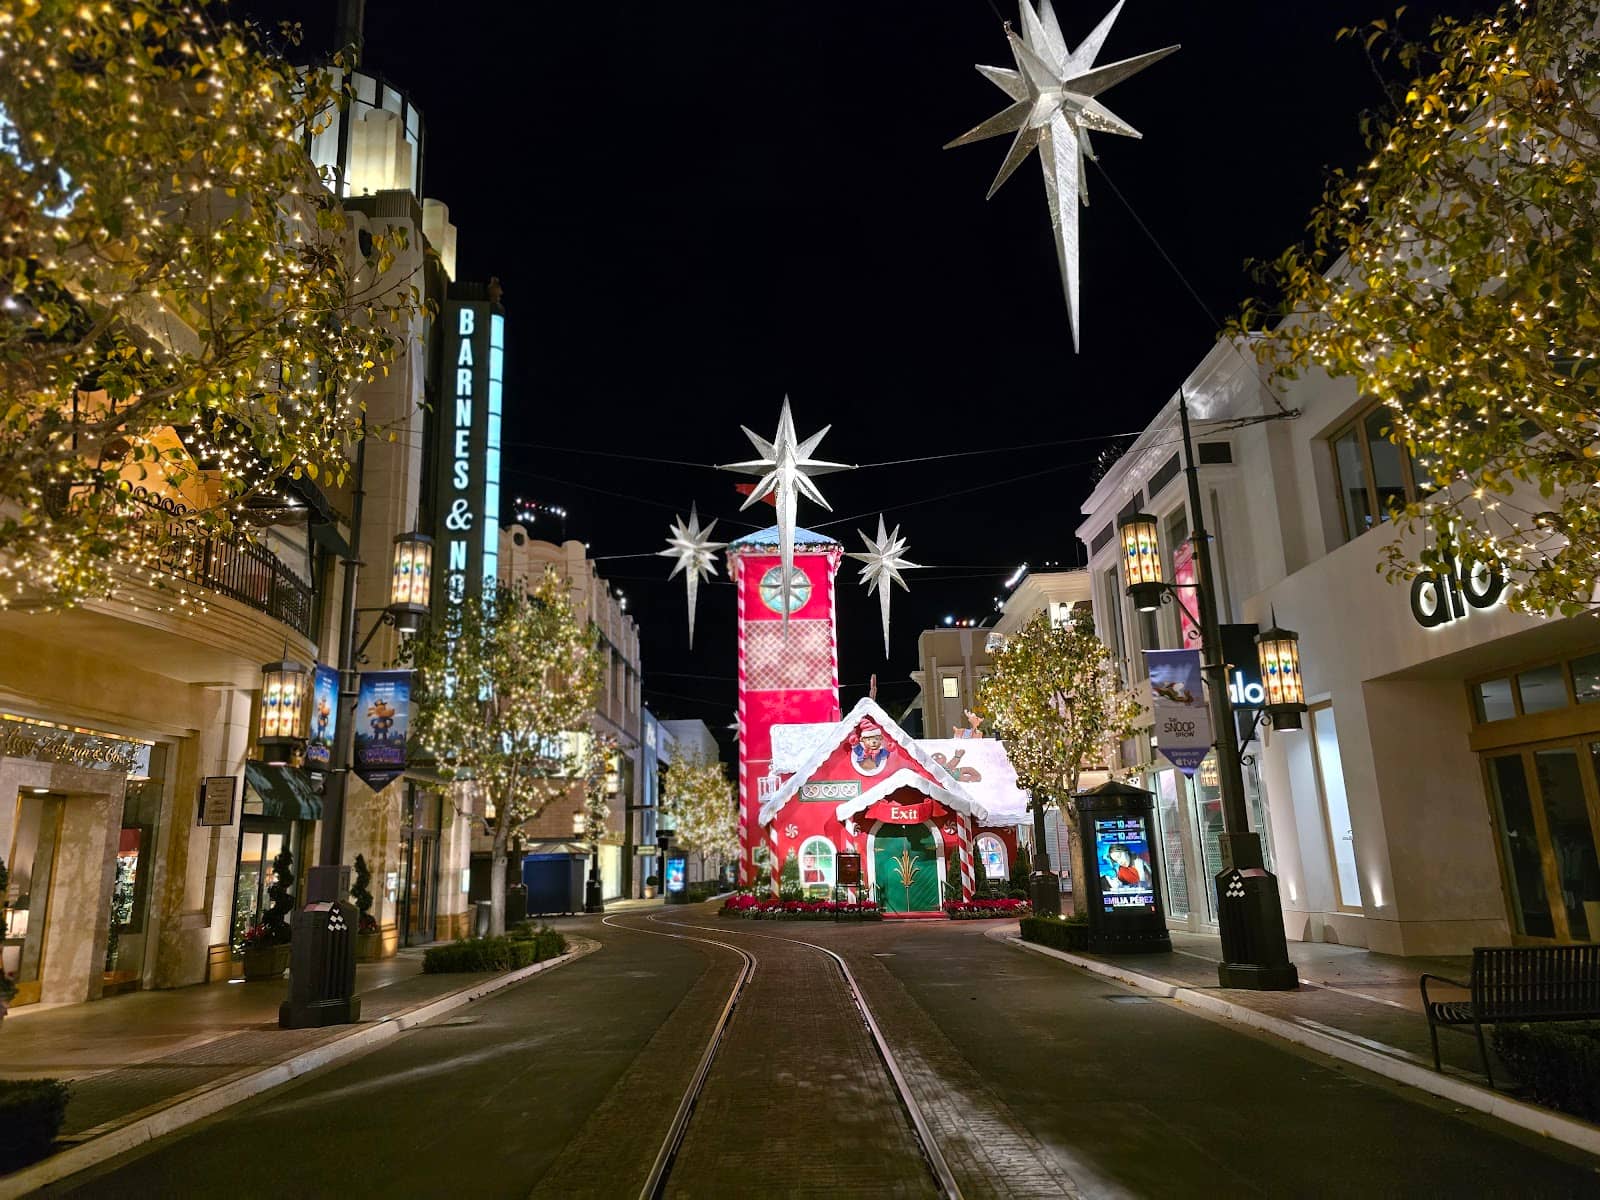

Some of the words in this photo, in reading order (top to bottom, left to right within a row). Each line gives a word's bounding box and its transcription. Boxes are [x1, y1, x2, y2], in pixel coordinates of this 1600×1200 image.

[453, 308, 475, 489] BARNES
[446, 498, 473, 531] &
[1410, 520, 1507, 628] alo
[1164, 722, 1195, 733] SNOOP
[891, 807, 917, 819] Exit
